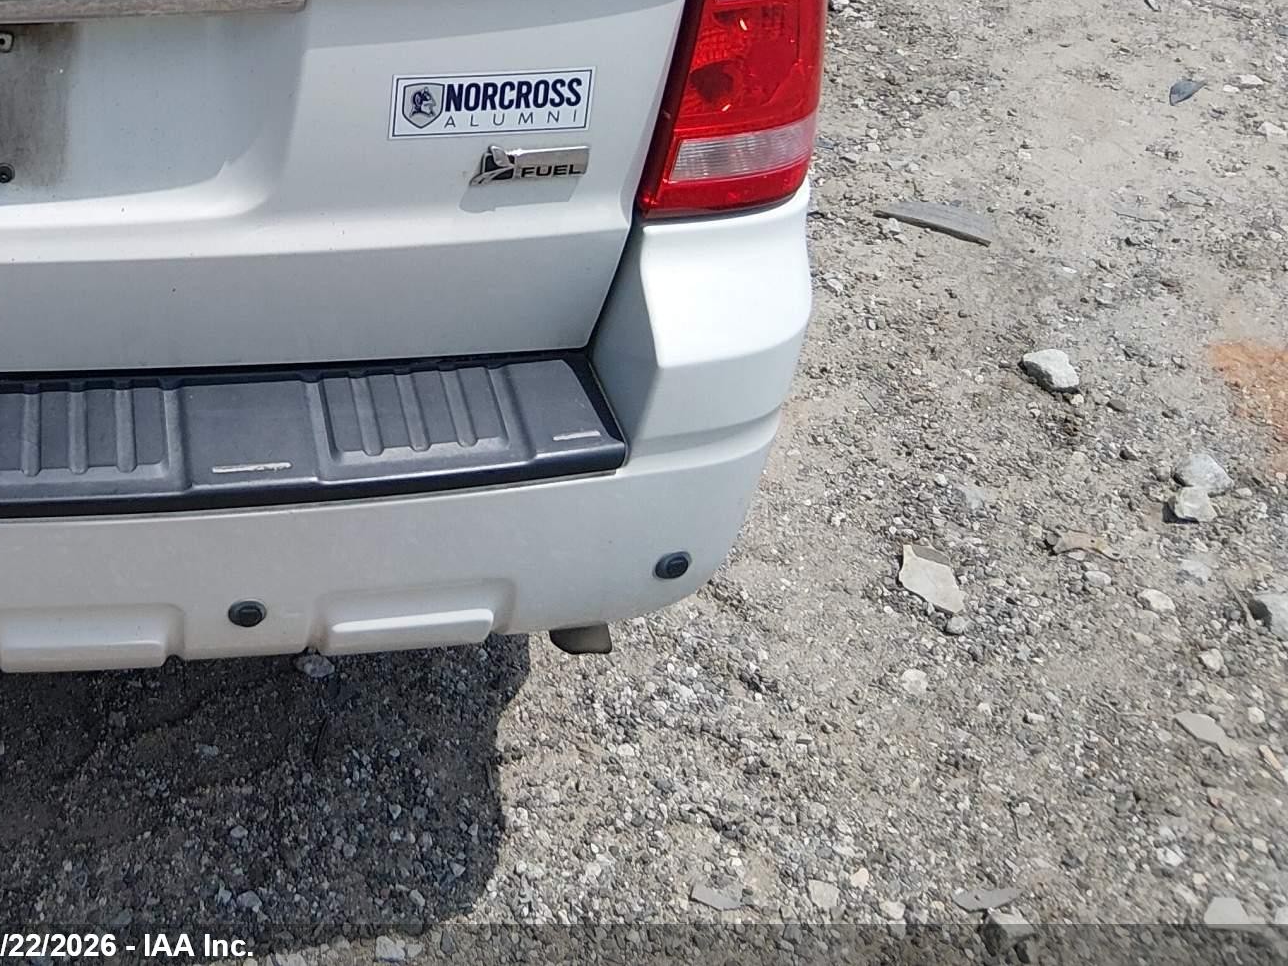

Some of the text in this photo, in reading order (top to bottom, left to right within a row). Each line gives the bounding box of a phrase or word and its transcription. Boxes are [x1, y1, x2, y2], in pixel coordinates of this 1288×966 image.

[444, 77, 583, 112] NORCROSS
[444, 109, 578, 128] ALUMNI
[520, 164, 582, 178] FUEL
